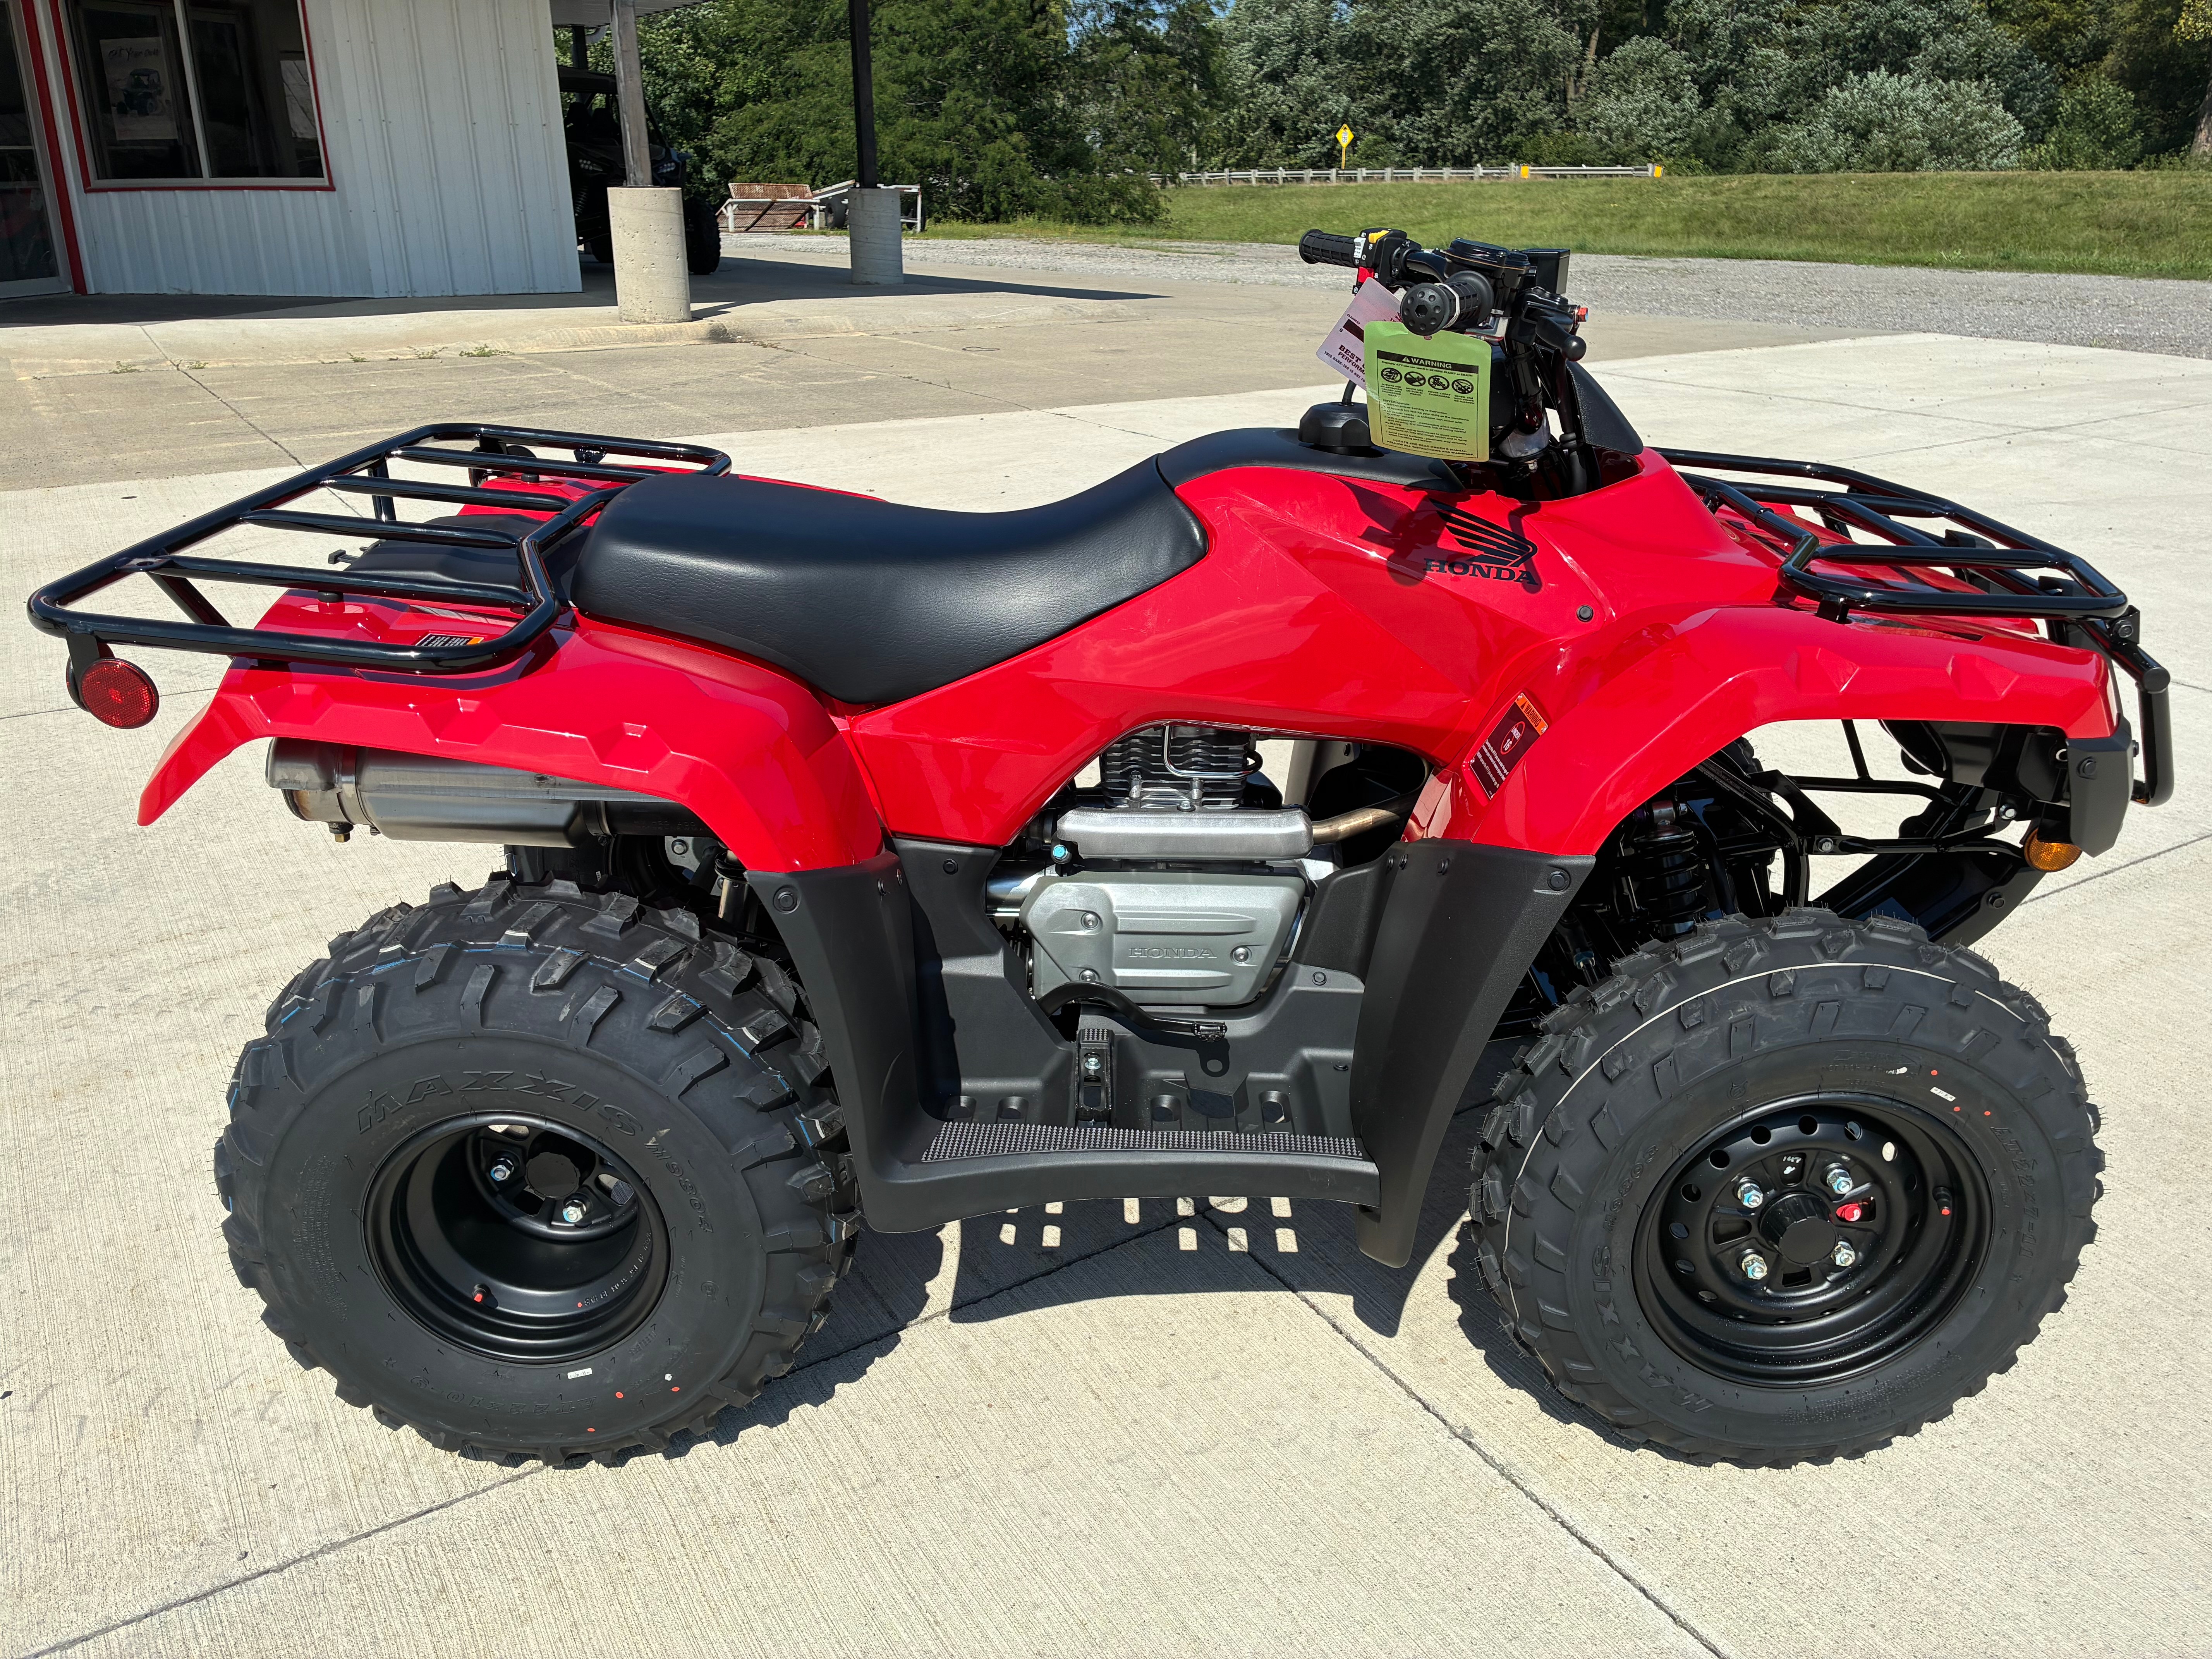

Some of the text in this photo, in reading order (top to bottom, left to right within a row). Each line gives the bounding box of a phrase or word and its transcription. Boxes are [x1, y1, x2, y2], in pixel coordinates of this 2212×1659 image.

[1339, 345, 1361, 362] BEST
[1411, 358, 1452, 369] WARNING
[1423, 558, 1538, 586] HONDA
[1523, 704, 1541, 728] WARNING
[1503, 739, 1512, 750] 16
[1128, 948, 1217, 958] HONDA
[357, 1071, 643, 1136] MAXXIS
[1592, 1245, 1714, 1413] MAXXIS
